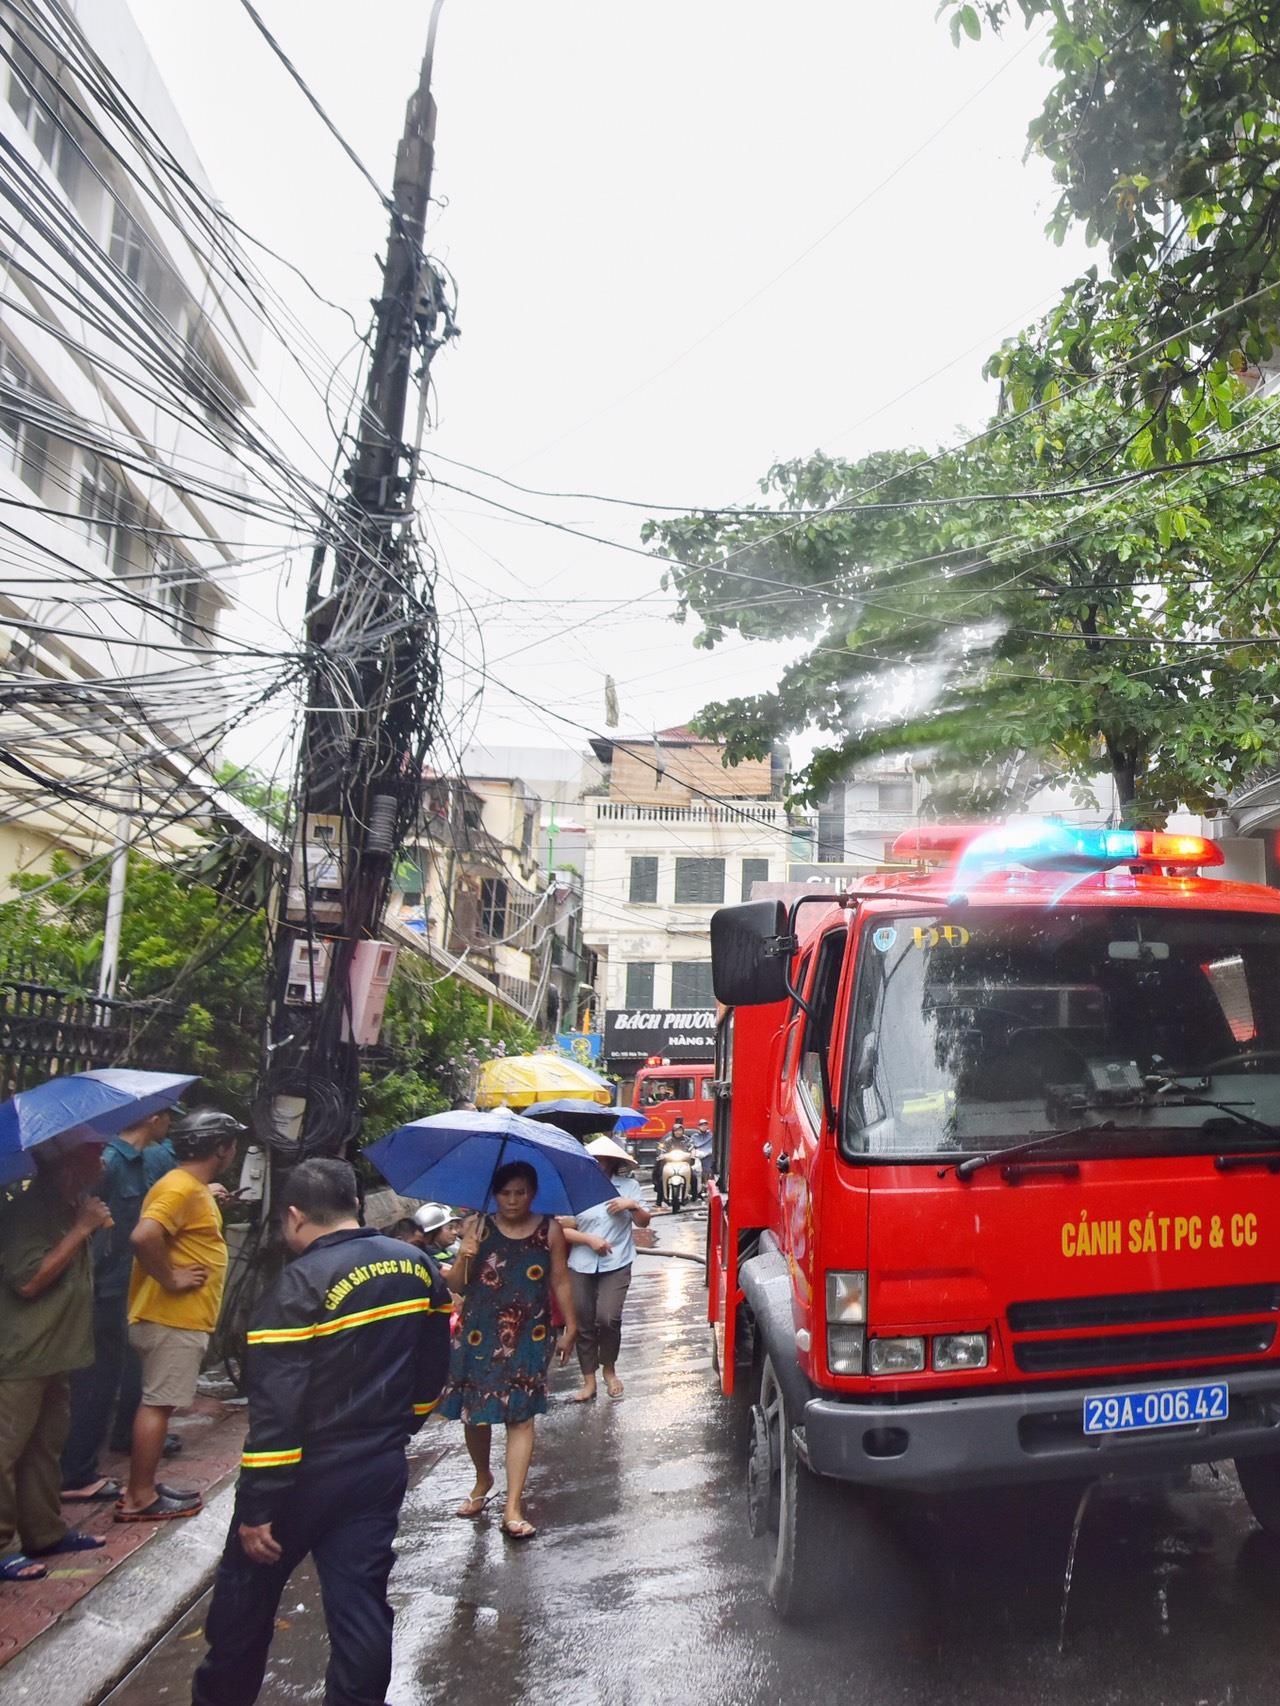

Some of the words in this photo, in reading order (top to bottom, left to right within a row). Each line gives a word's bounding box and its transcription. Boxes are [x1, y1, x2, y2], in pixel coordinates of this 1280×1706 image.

[614, 1010, 662, 1030] BÁCH
[662, 1010, 717, 1030] PHƯƠN
[668, 1034, 705, 1046] HÀNG
[1061, 1209, 1122, 1258] CẢNH
[1128, 1211, 1171, 1254] SÁT
[1174, 1215, 1202, 1251] PC
[1208, 1215, 1224, 1248] &
[1231, 1212, 1258, 1248] CC
[325, 1278, 354, 1311] CẢNH
[348, 1264, 371, 1286] SÁT
[368, 1259, 399, 1277] PCCC
[399, 1258, 413, 1275] VÀ
[1088, 1386, 1224, 1430] 29A-006.42
